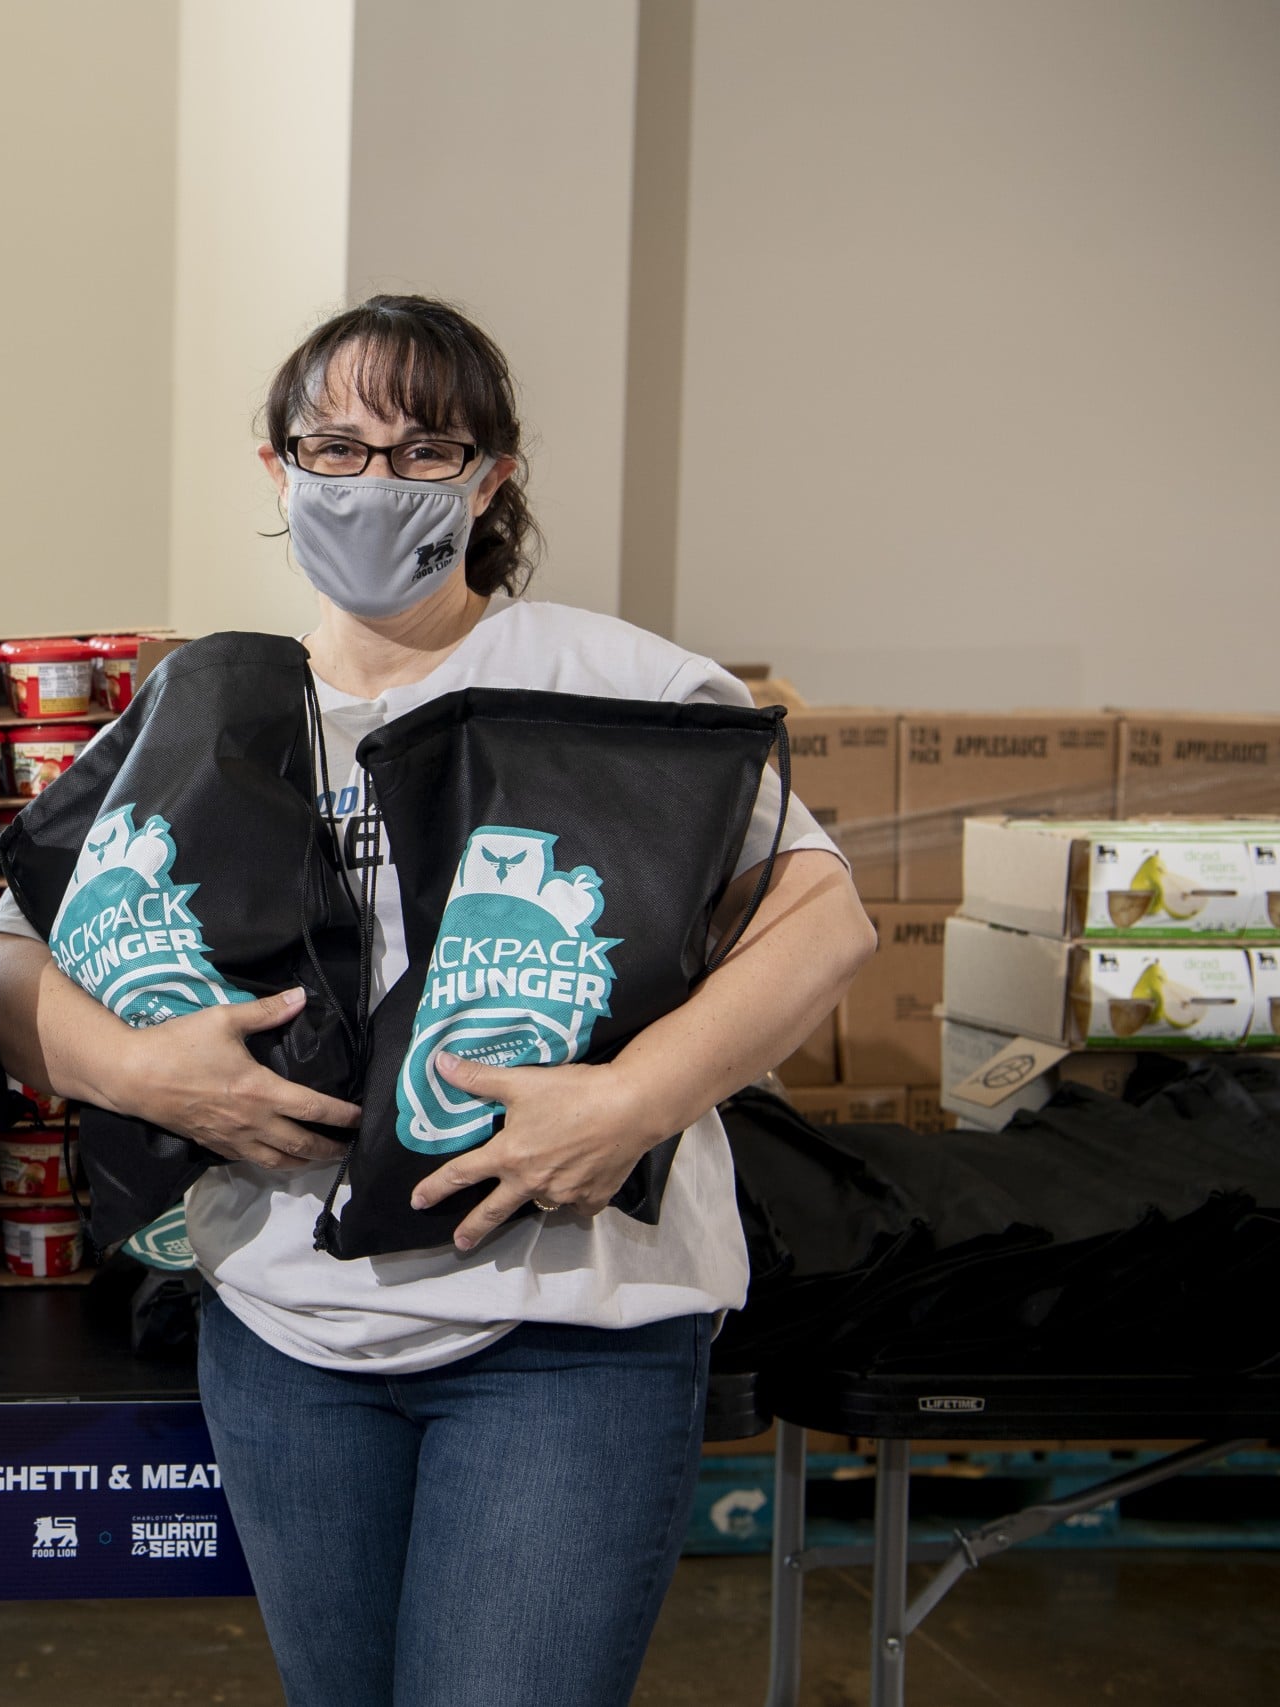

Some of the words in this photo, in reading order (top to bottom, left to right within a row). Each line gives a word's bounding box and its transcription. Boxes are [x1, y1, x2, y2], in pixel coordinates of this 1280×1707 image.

[954, 735, 1048, 757] APPLESAUCE
[316, 786, 359, 815] OD
[76, 928, 202, 997] HUNGER
[428, 936, 608, 973] ACKPACK
[431, 967, 606, 1010] HUNGER
[458, 1039, 523, 1056] PRESENTED
[926, 1399, 978, 1409] LIFETIME
[108, 1464, 131, 1489] &
[131, 1522, 217, 1540] SWARM
[32, 1549, 55, 1558] FOOD
[57, 1549, 77, 1557] LION
[131, 1541, 149, 1556] to
[149, 1540, 217, 1558] SERVE
